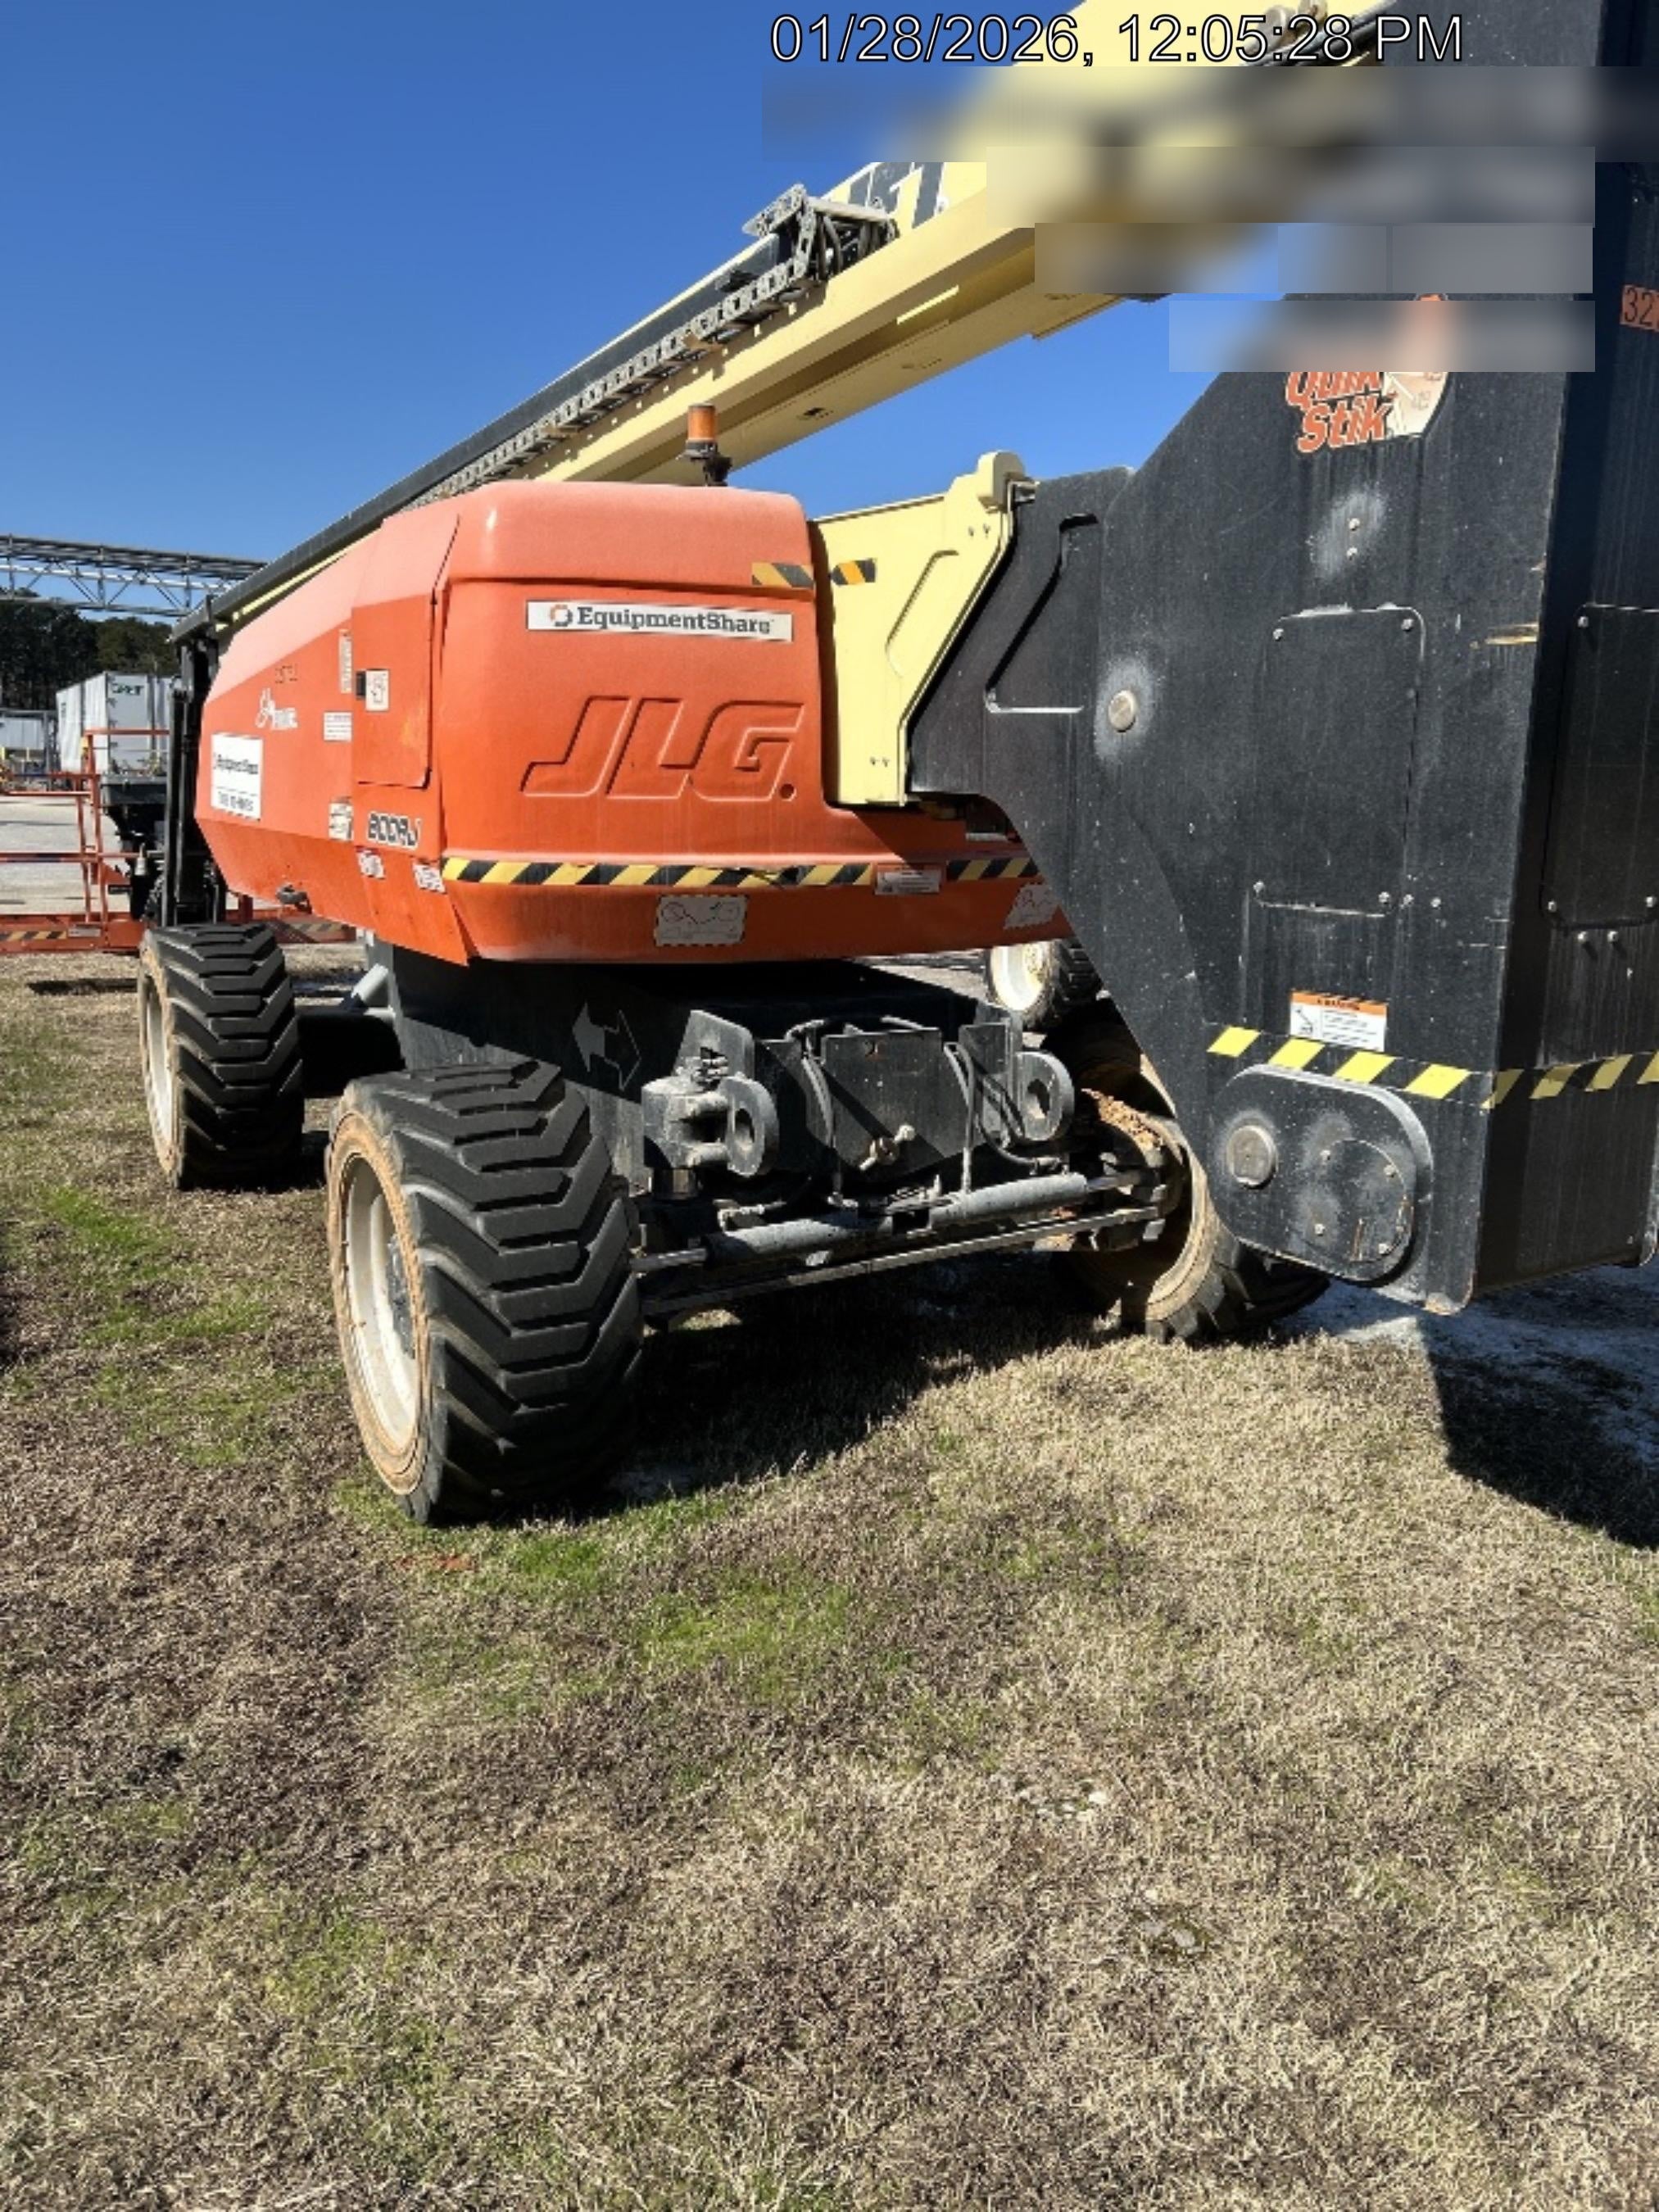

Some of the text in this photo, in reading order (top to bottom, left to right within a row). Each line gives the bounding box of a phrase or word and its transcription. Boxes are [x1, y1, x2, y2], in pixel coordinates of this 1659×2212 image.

[1625, 287, 1659, 327] 32
[1298, 394, 1393, 453] Stik
[577, 607, 770, 635] EquipmentShare
